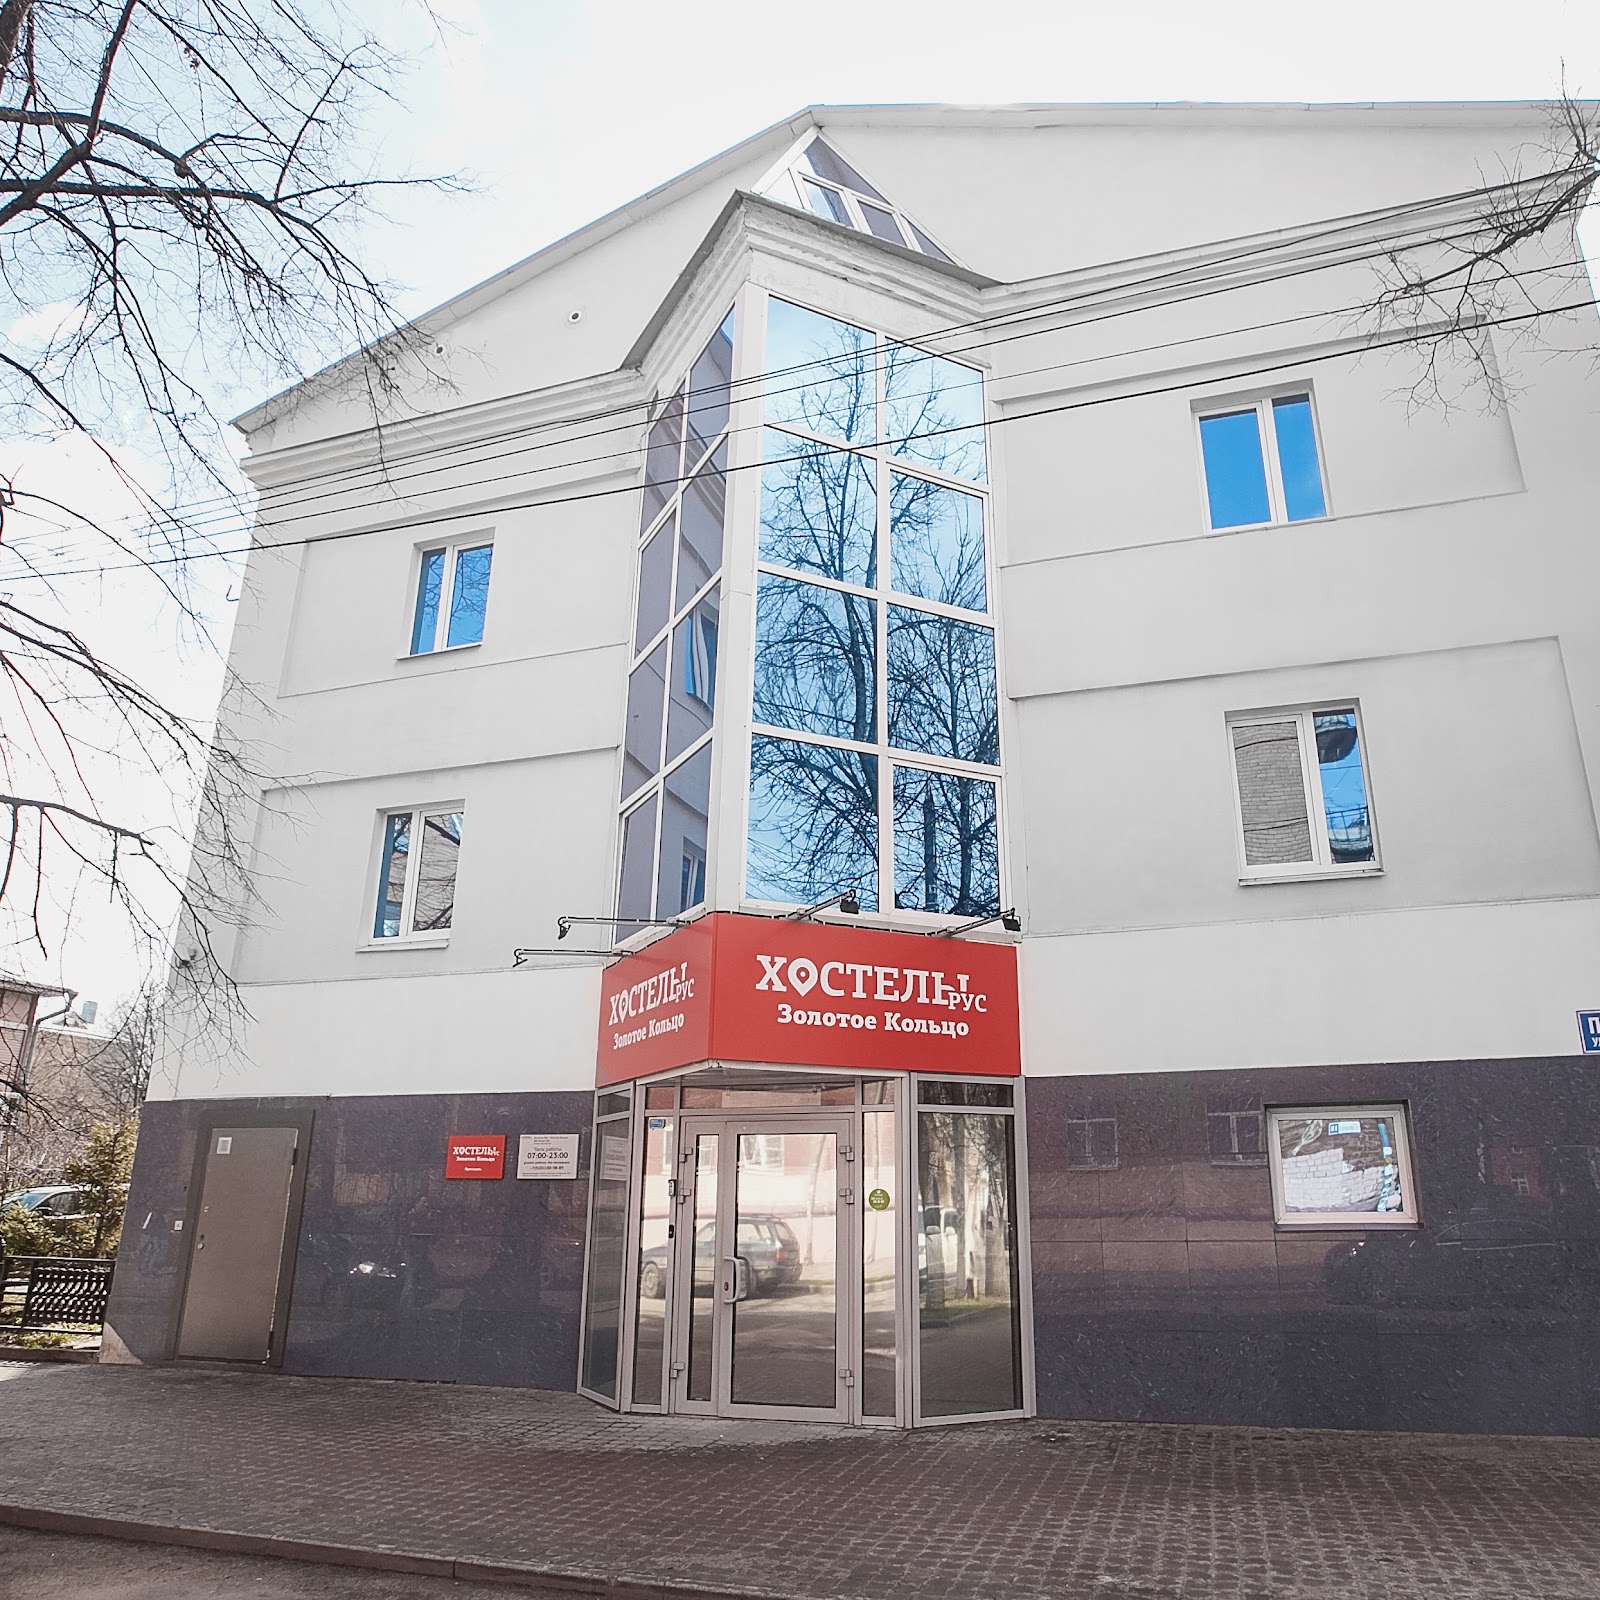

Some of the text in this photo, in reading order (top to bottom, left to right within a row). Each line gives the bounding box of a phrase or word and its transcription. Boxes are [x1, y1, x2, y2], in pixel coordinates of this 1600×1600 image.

[608, 962, 688, 1026] ХОСТЕЛЫ
[756, 955, 969, 1005] ХОСТЕЛЫ
[613, 1013, 685, 1050] Золотое Кольцо
[777, 1003, 969, 1039] Золотое Кольцо
